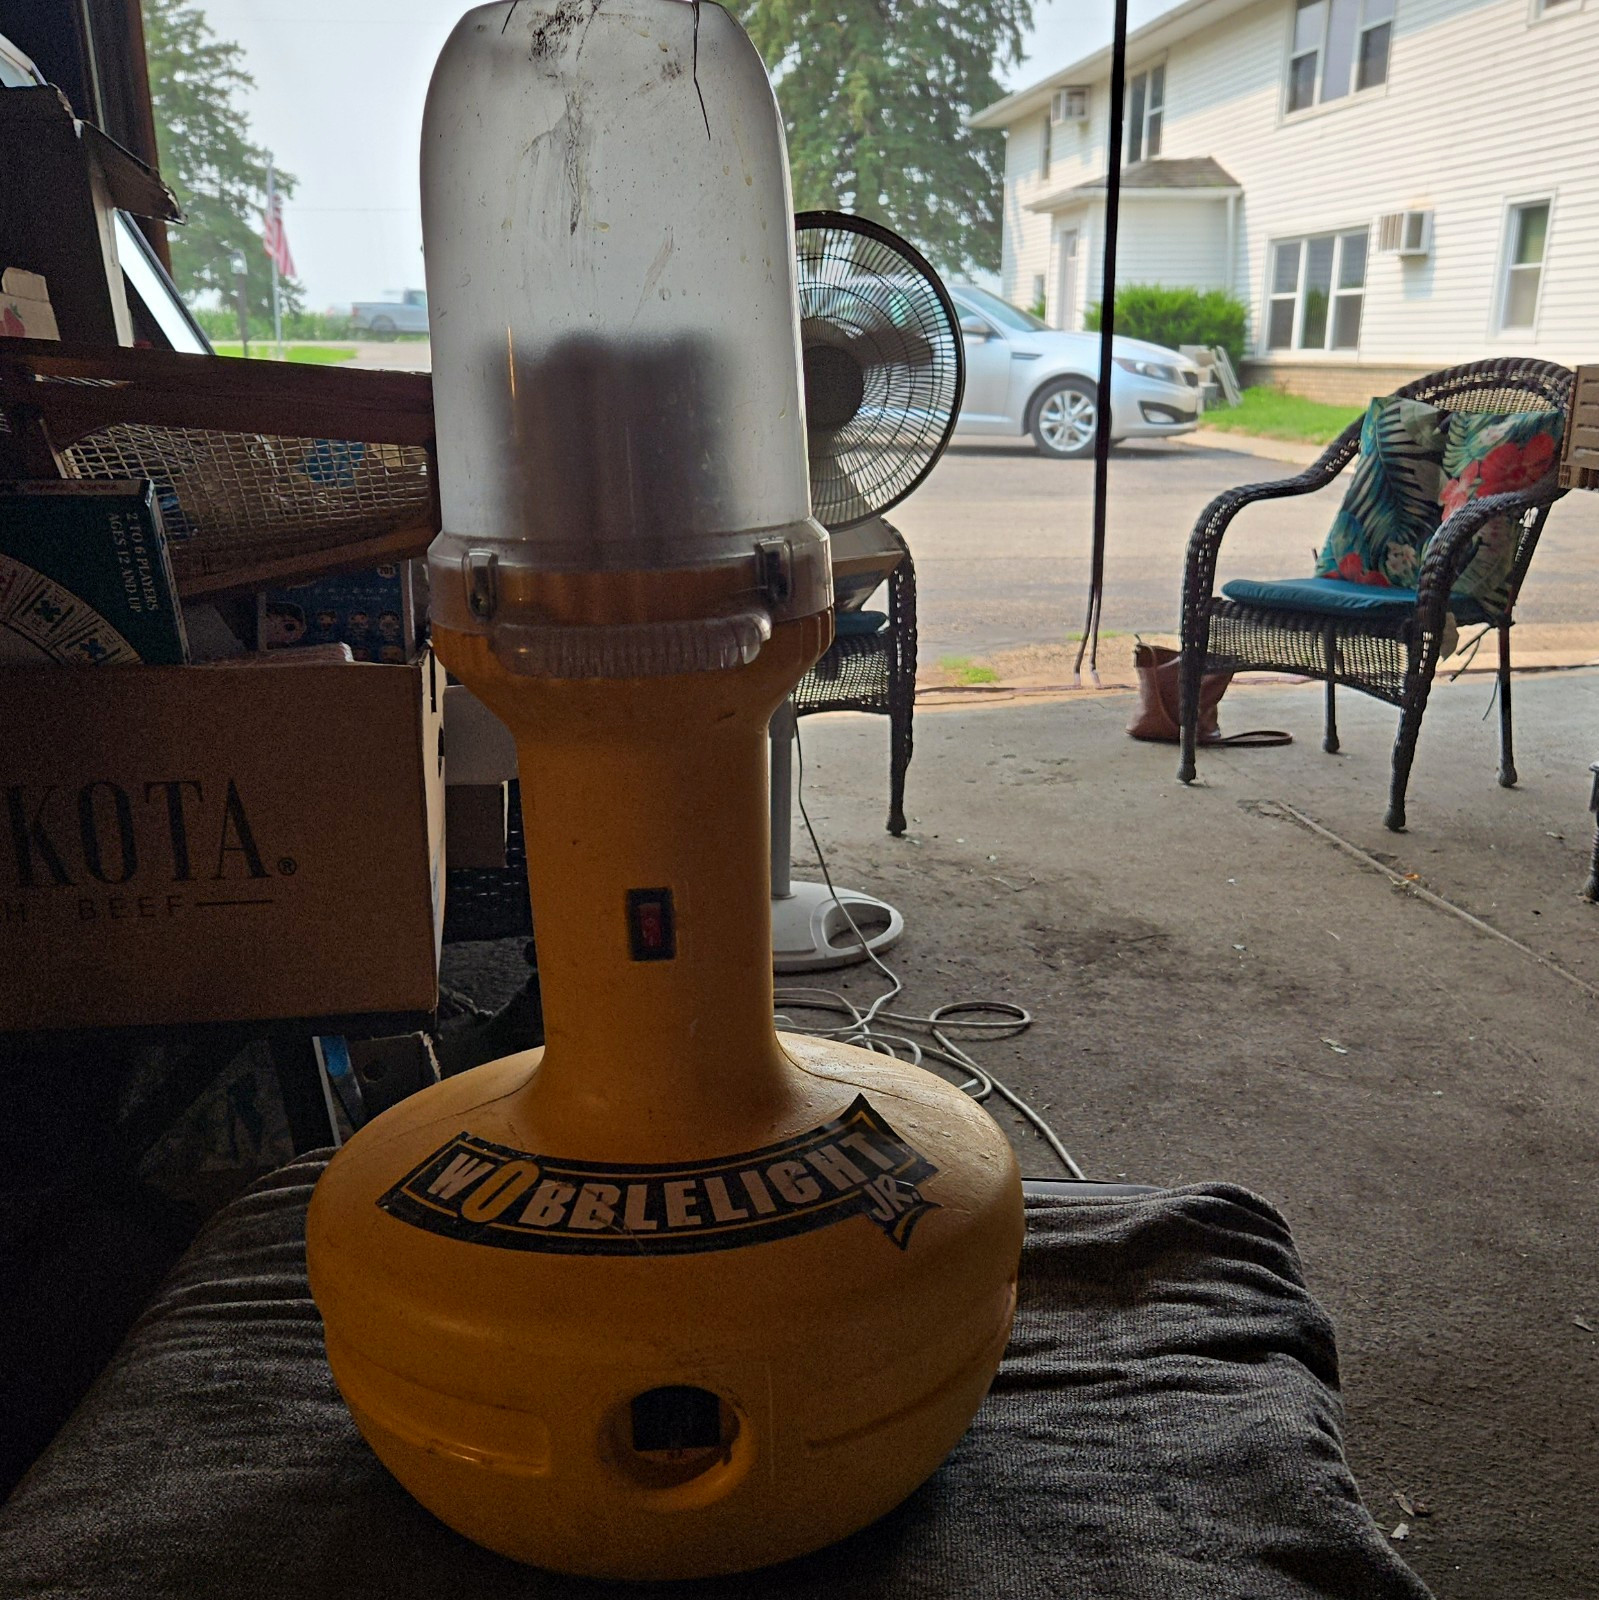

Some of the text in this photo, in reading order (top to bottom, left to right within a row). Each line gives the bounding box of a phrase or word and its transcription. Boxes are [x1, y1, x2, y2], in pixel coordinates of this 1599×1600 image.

[108, 512, 142, 613] AGES 12 AND UP
[126, 513, 159, 611] 2 TO 6 PLAYERS
[79, 895, 186, 921] BEEF
[427, 1131, 896, 1231] WOBBLELIGHT
